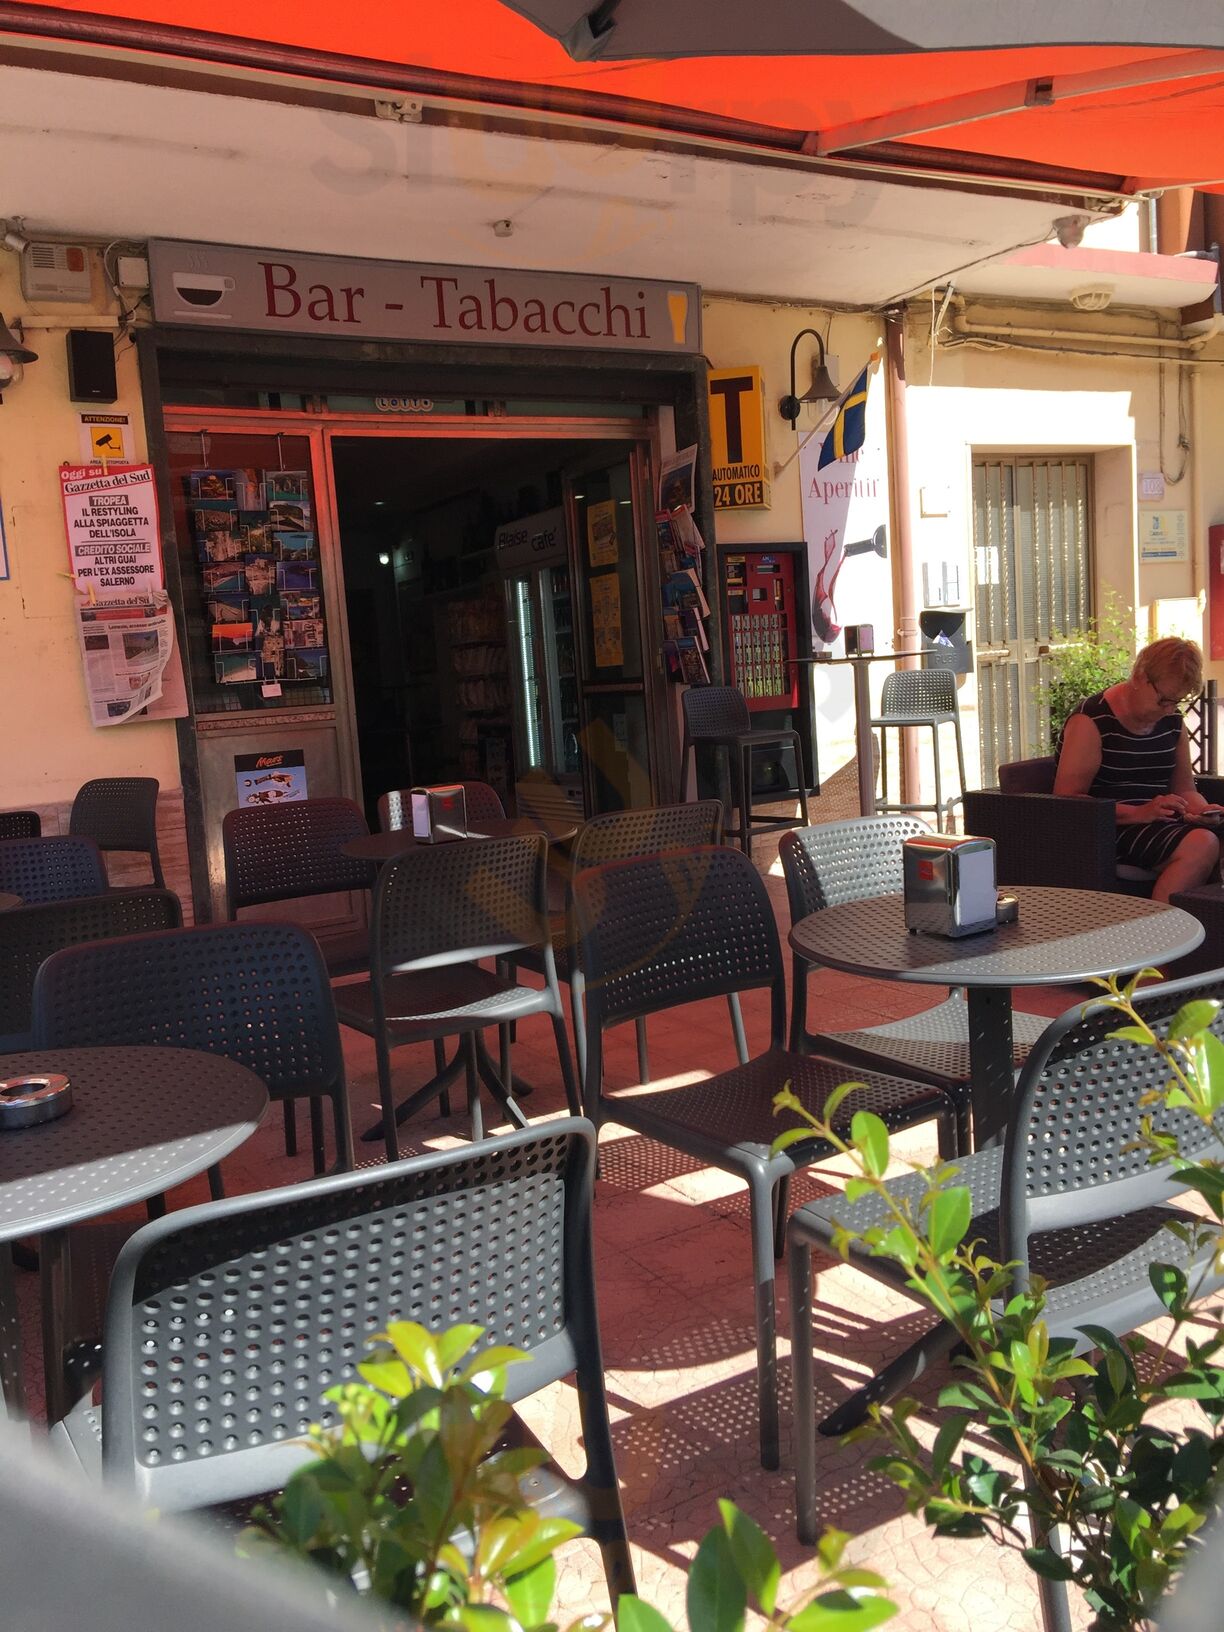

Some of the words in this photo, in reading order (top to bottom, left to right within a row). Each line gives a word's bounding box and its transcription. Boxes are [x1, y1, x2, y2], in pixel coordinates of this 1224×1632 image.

[257, 262, 365, 324] Bar
[385, 302, 404, 311] -
[420, 274, 651, 340] Tabacchi
[710, 376, 753, 464] T
[712, 464, 760, 482] AUTOMATICO
[65, 478, 112, 494] Gazzetta
[112, 474, 128, 486] del
[130, 470, 150, 482] Sud
[714, 486, 731, 507] 24
[735, 483, 762, 504] ORE
[92, 496, 126, 506] TROPEA
[82, 508, 90, 516] IL
[92, 506, 138, 516] RESTYLING
[74, 518, 94, 528] ALLA
[96, 517, 149, 527] SPIAGGETTA
[90, 528, 136, 538] DELL'ISOLA
[78, 545, 115, 555] CREDITO
[116, 544, 150, 554] SOCIALE
[94, 556, 116, 565] ALTRI
[118, 555, 136, 564] GUAI
[78, 568, 92, 577] PER
[94, 568, 111, 576] L'EX
[112, 565, 154, 574] ASSESSORE
[100, 576, 135, 586] SALERNO
[127, 597, 137, 606] del
[256, 755, 284, 768] Mars
